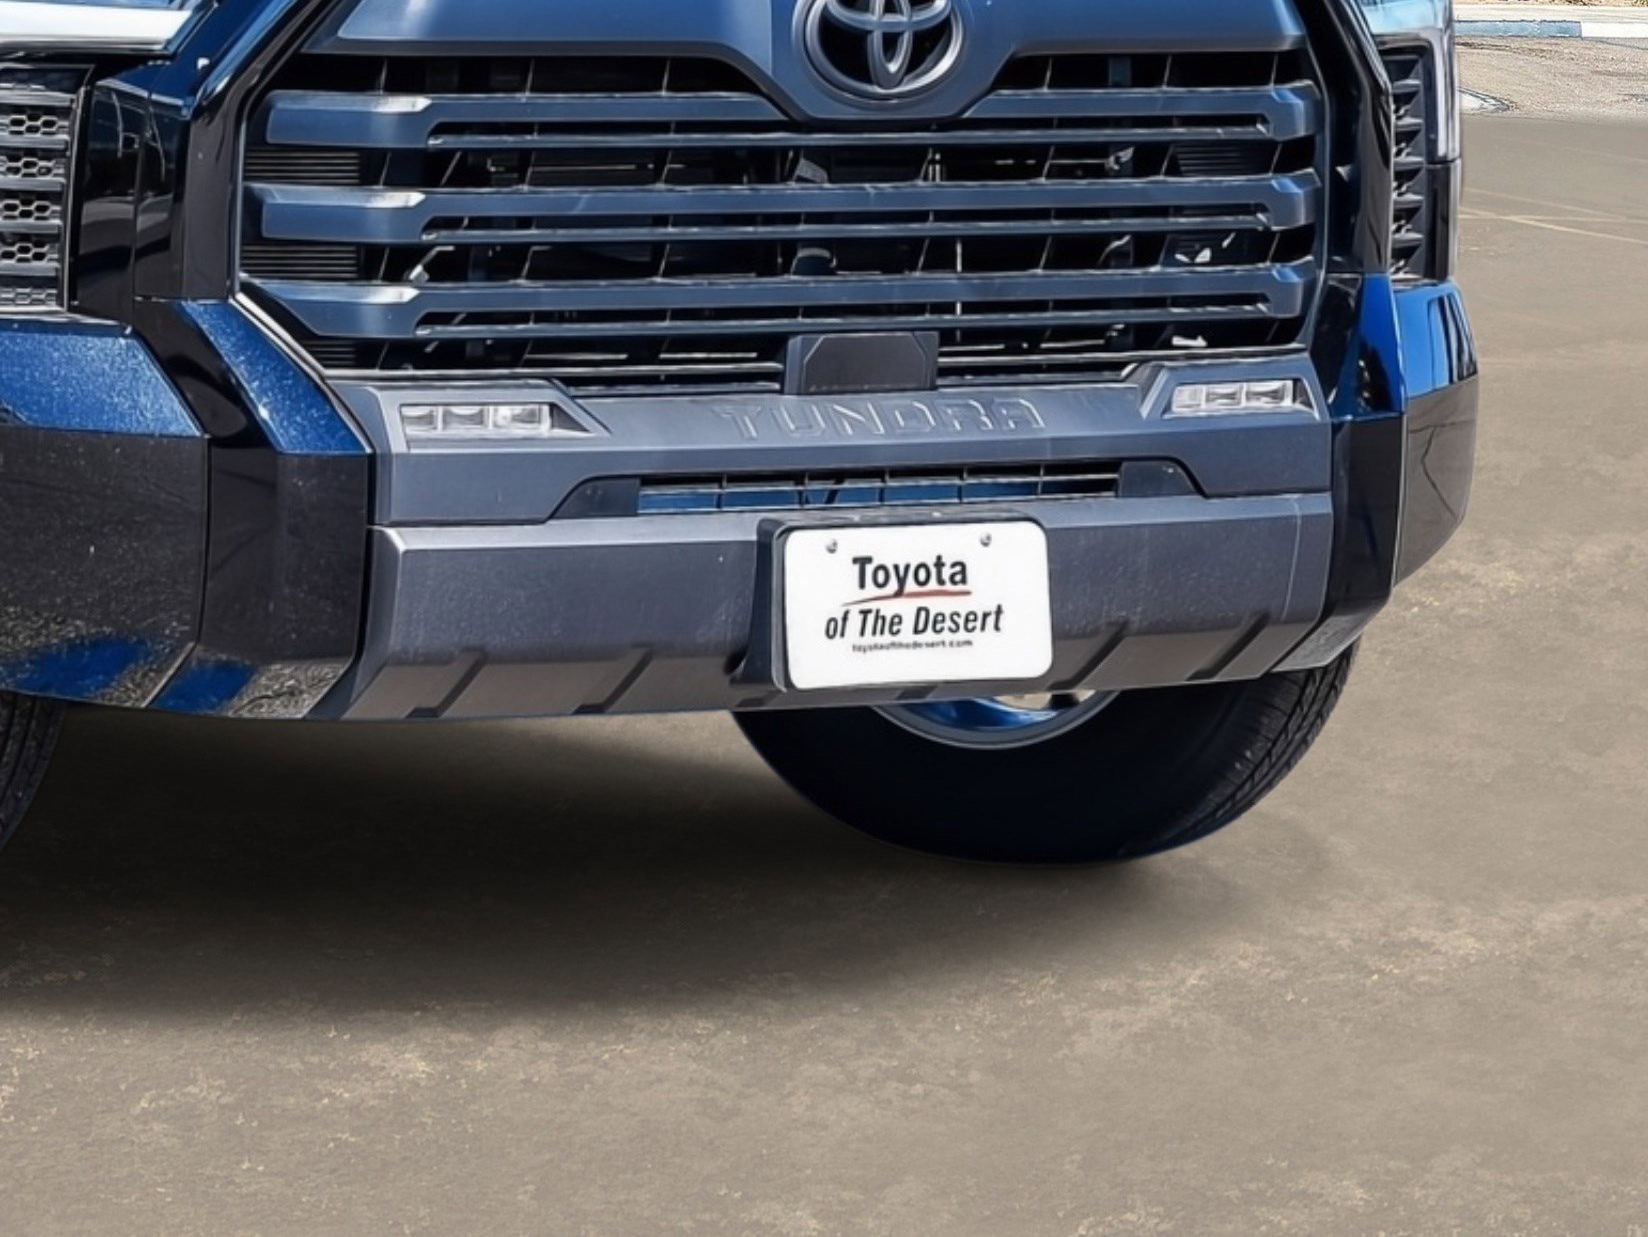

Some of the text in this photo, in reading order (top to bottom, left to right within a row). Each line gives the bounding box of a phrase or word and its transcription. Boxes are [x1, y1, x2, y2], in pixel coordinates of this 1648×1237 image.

[714, 398, 1046, 441] TUNDRA
[852, 555, 968, 598] Toyota
[825, 604, 1004, 640] of The Desert
